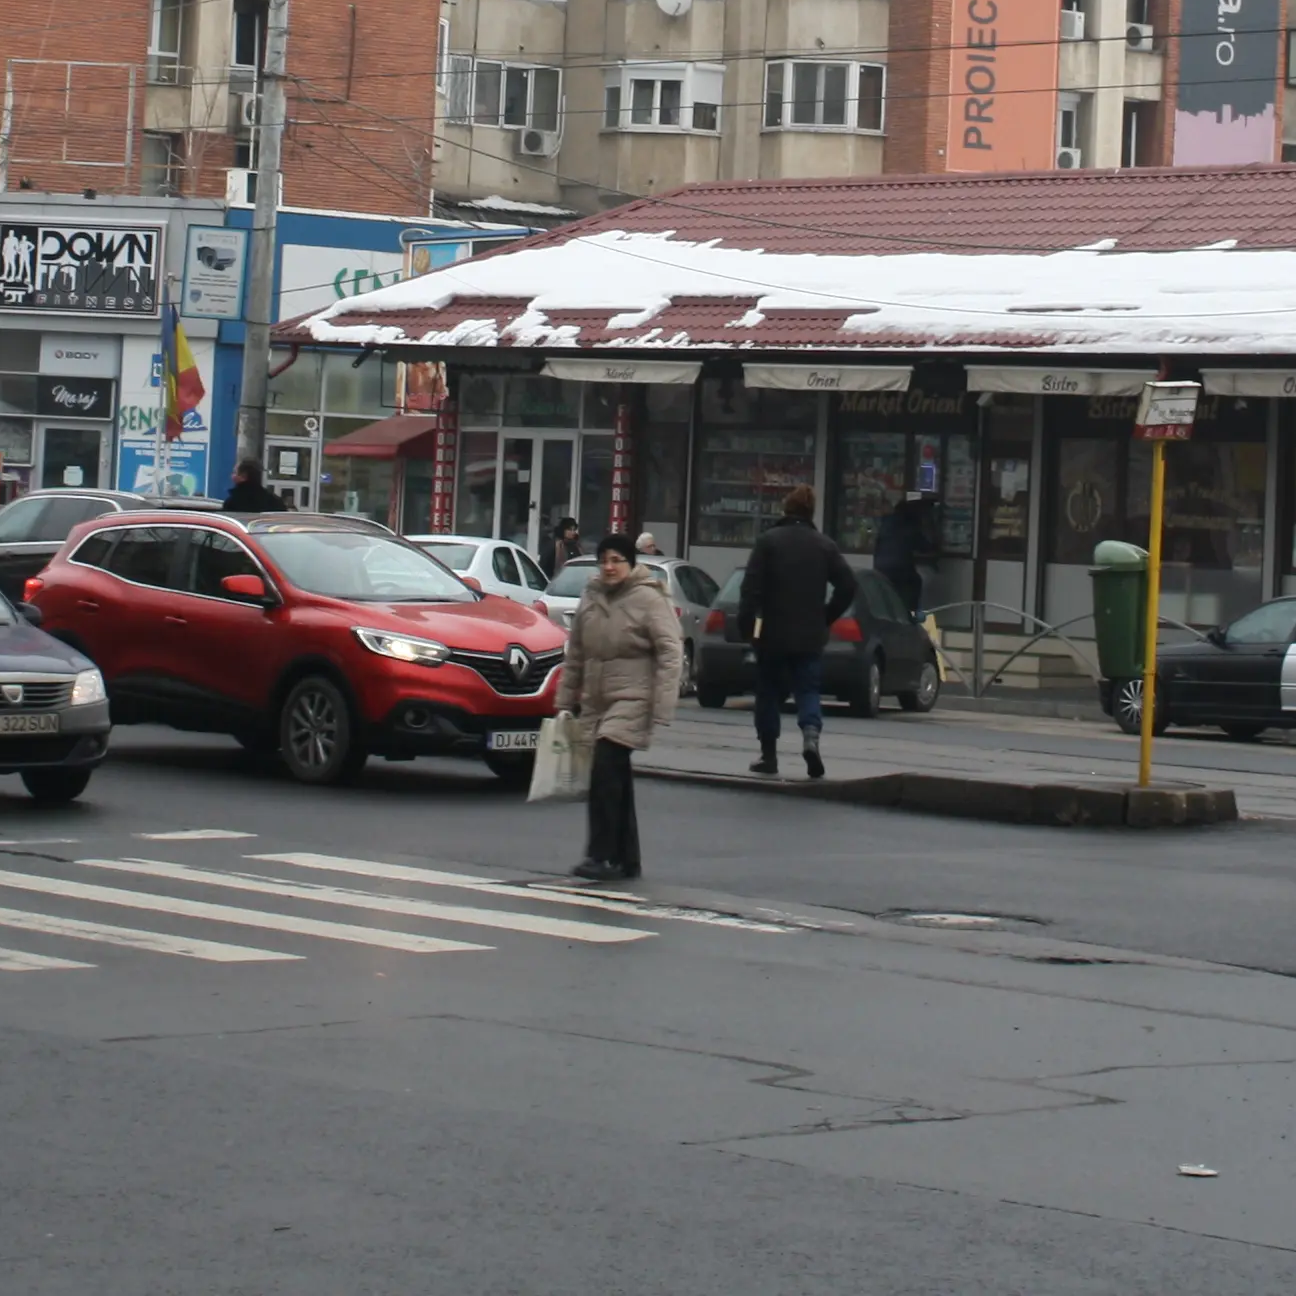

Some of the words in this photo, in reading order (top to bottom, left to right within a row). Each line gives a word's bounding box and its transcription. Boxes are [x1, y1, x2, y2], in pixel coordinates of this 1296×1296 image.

[40, 230, 155, 265] DOWN
[40, 263, 154, 296] TOWN
[36, 293, 154, 311] FITNESS
[65, 351, 99, 360] BODY
[807, 372, 842, 389] Orient
[1042, 374, 1079, 391] Bistro
[52, 385, 98, 411] Masaj
[611, 404, 626, 535] FLORARIE
[3, 716, 27, 732] 322
[29, 715, 57, 731] SUN
[496, 733, 511, 747] DJ
[514, 733, 527, 746] 44
